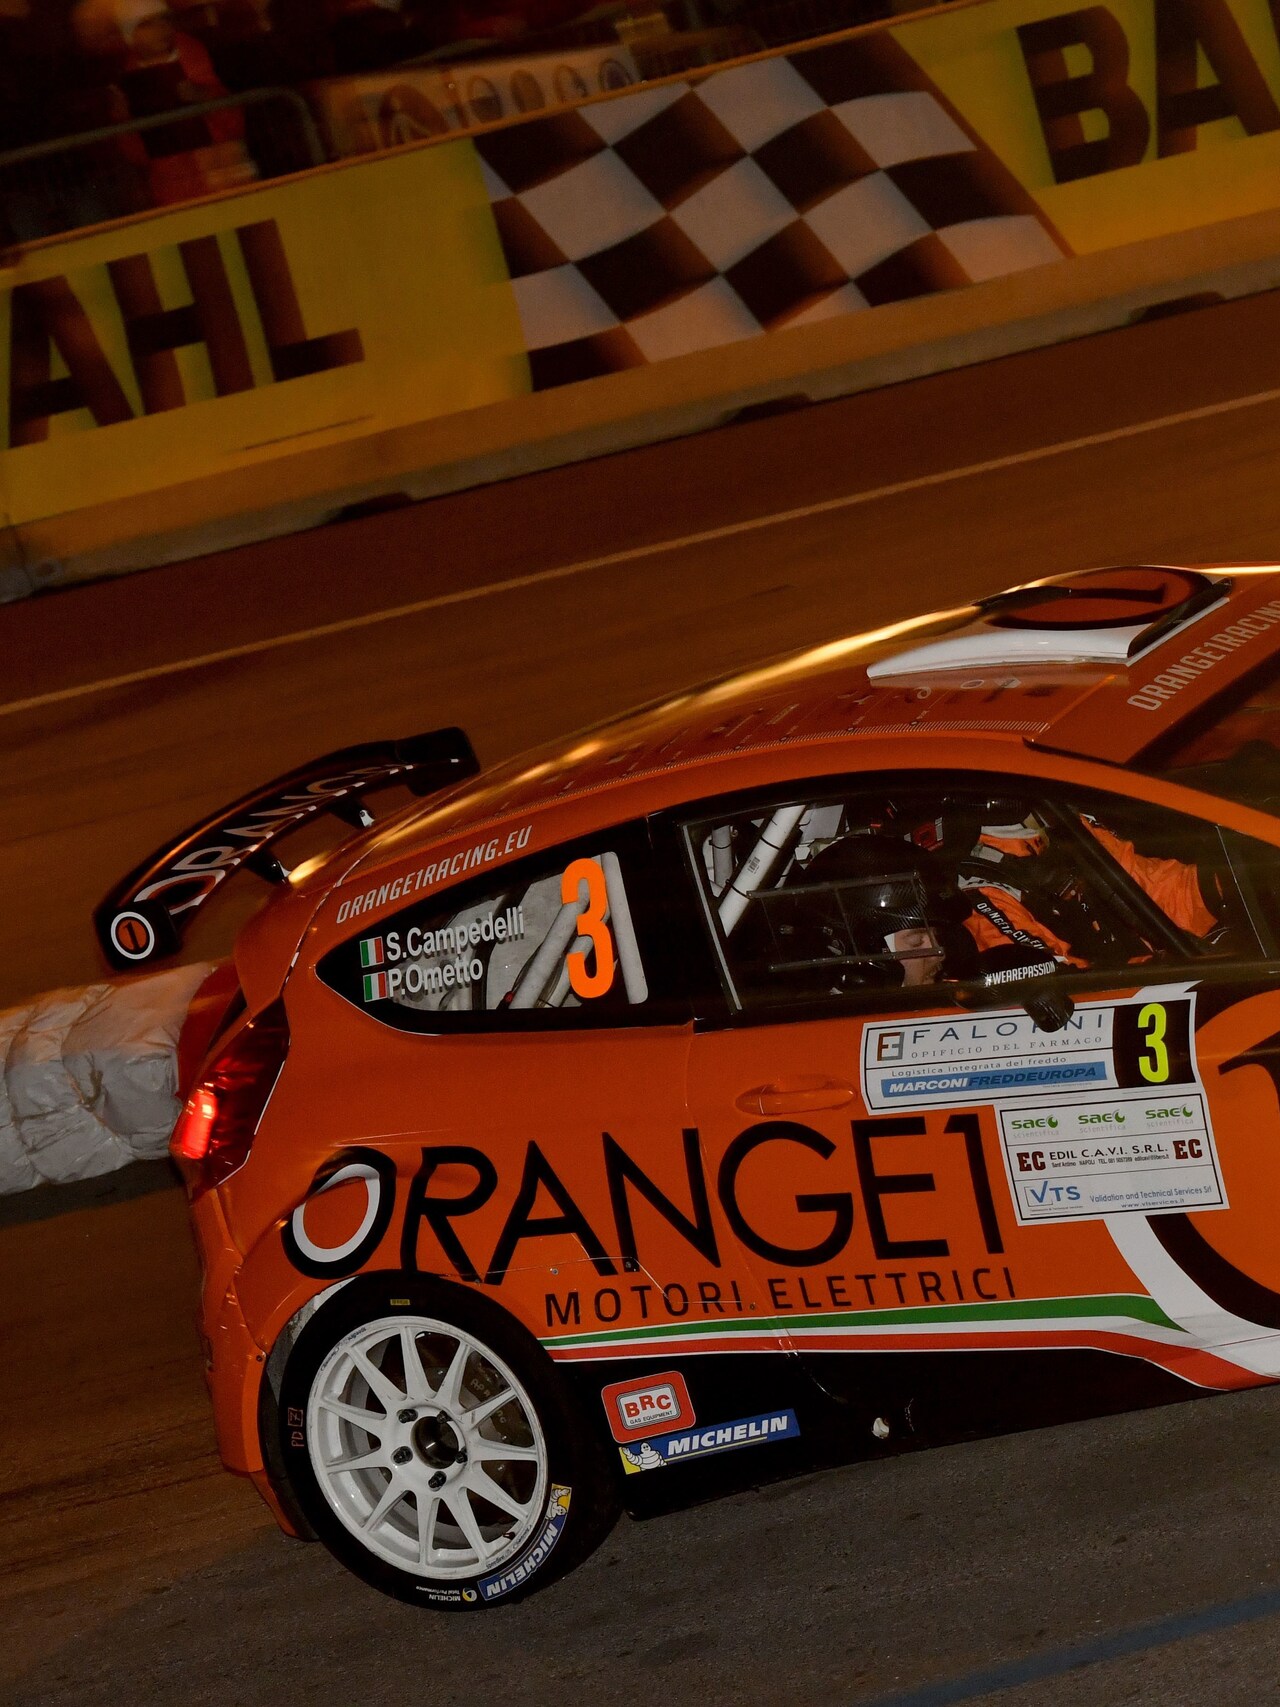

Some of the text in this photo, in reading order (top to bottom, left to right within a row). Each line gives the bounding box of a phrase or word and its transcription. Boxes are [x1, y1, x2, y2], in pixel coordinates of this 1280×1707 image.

[336, 825, 533, 924] ORANGE1RACING.EU
[386, 905, 525, 962] S.Campedelli
[561, 857, 614, 998] 3
[389, 957, 484, 998] P.Ometto
[984, 961, 1056, 987] #WEAREPASSION
[911, 1036, 1103, 1059] OPIFICIO DEL FARMACO
[1137, 1003, 1170, 1083] 3
[892, 1056, 1067, 1078] Logistica integrata del freddo
[1013, 1117, 1194, 1139] scientifica scientifica scientifica
[1016, 1138, 1203, 1172] EC EDIL C.A.V.I. S.R.L. EC
[281, 1112, 1008, 1286] ORANGE1
[1030, 1181, 1212, 1203] VTS Validation and Technical Services Srl
[545, 1267, 1017, 1327] MOTORI ELETTRICI
[624, 1394, 672, 1418] BRC
[629, 1410, 673, 1425] GAS EQUIPMENT
[667, 1415, 788, 1456] MICHELIN
[487, 1524, 558, 1597] MICHELIN
[429, 1593, 461, 1602] MICHELIN
